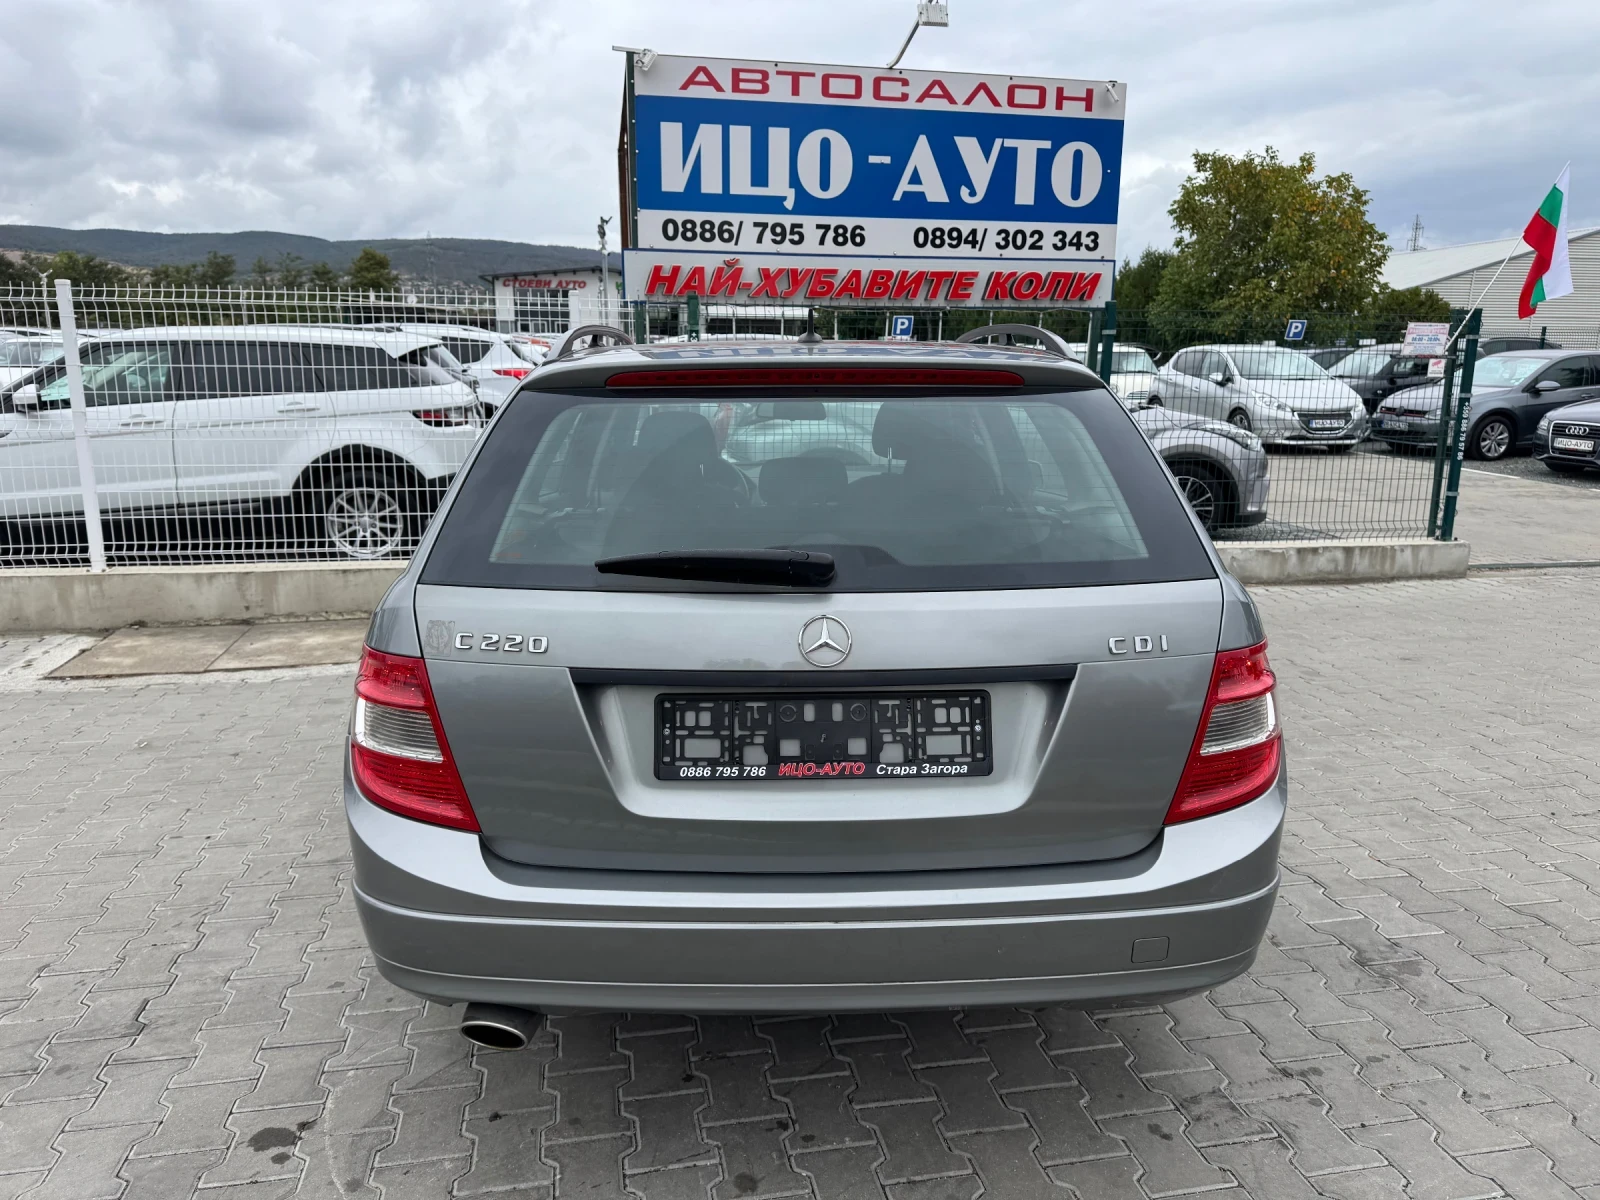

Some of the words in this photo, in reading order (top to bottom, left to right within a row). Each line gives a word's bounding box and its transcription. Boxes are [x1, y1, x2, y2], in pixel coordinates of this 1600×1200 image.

[678, 65, 1094, 113] АВТОСАЛОН
[661, 218, 744, 246] 0886/
[753, 221, 805, 245] 795
[815, 223, 866, 247] 786
[913, 226, 988, 252] 0894/
[995, 228, 1044, 251] 302
[1052, 230, 1100, 252] 343
[502, 278, 552, 288] СТОЕВИ
[555, 279, 587, 289] АУТО
[644, 257, 980, 301] НАЙ-ХУБАВИТЕ
[983, 271, 1102, 301] КОЛИ
[896, 318, 909, 334] P
[1289, 322, 1302, 337] P
[1459, 432, 1467, 441] 79
[1458, 442, 1465, 450] 57
[1108, 634, 1168, 654] CDI
[679, 766, 711, 777] 0886
[715, 766, 739, 777] 795
[743, 766, 766, 777] 786
[778, 762, 866, 778] ИЦО-АУТО
[876, 763, 918, 776] Стара
[920, 763, 968, 775] Загора
